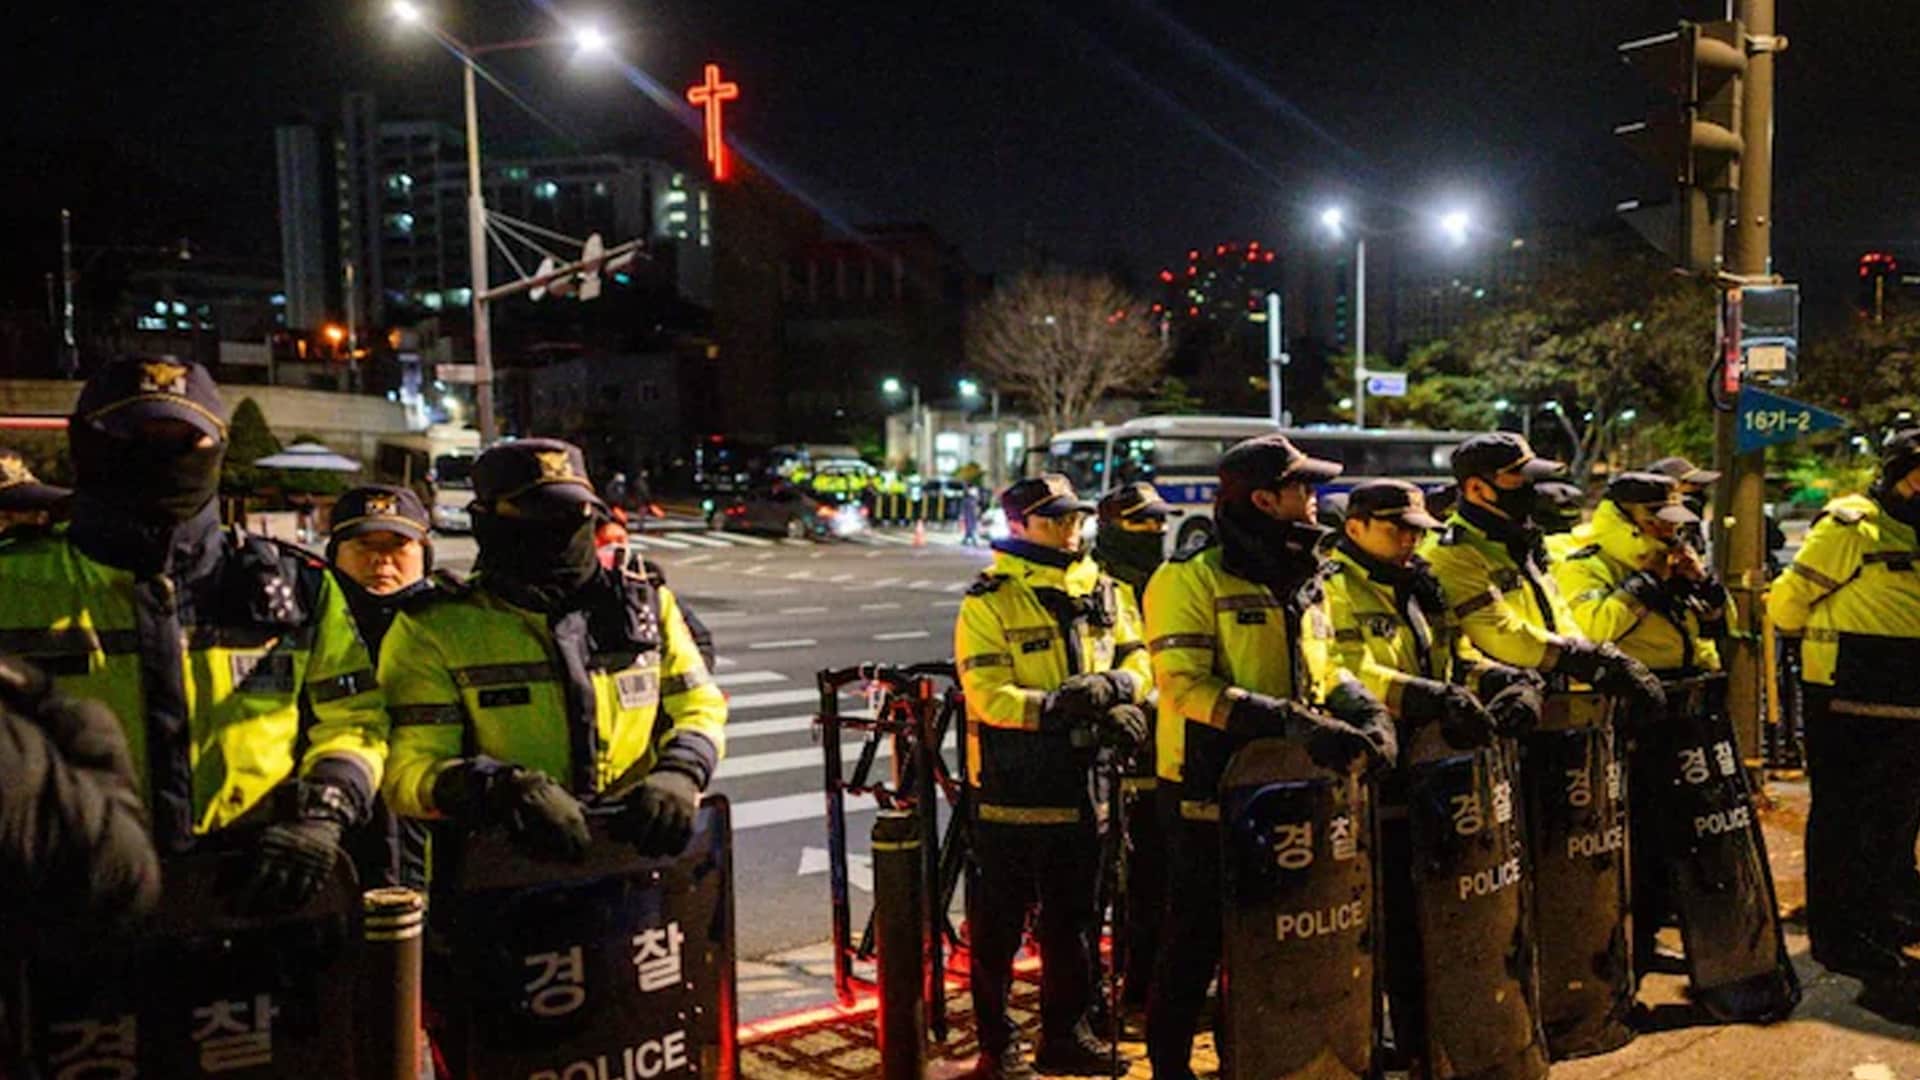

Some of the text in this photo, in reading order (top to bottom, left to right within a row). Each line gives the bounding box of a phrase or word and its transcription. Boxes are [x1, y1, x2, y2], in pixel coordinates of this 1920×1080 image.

[1744, 409, 1811, 432] 16기-2
[1678, 746, 1709, 784] 경
[1273, 815, 1358, 870] 경 찰
[1568, 825, 1623, 859] POLICE
[1694, 806, 1750, 838] POLICE
[1459, 858, 1521, 900] POLICE
[1276, 900, 1364, 941] POLICE
[524, 921, 685, 1016] 경 찰
[192, 994, 280, 1072] 찰
[529, 1030, 688, 1080] OLICE
